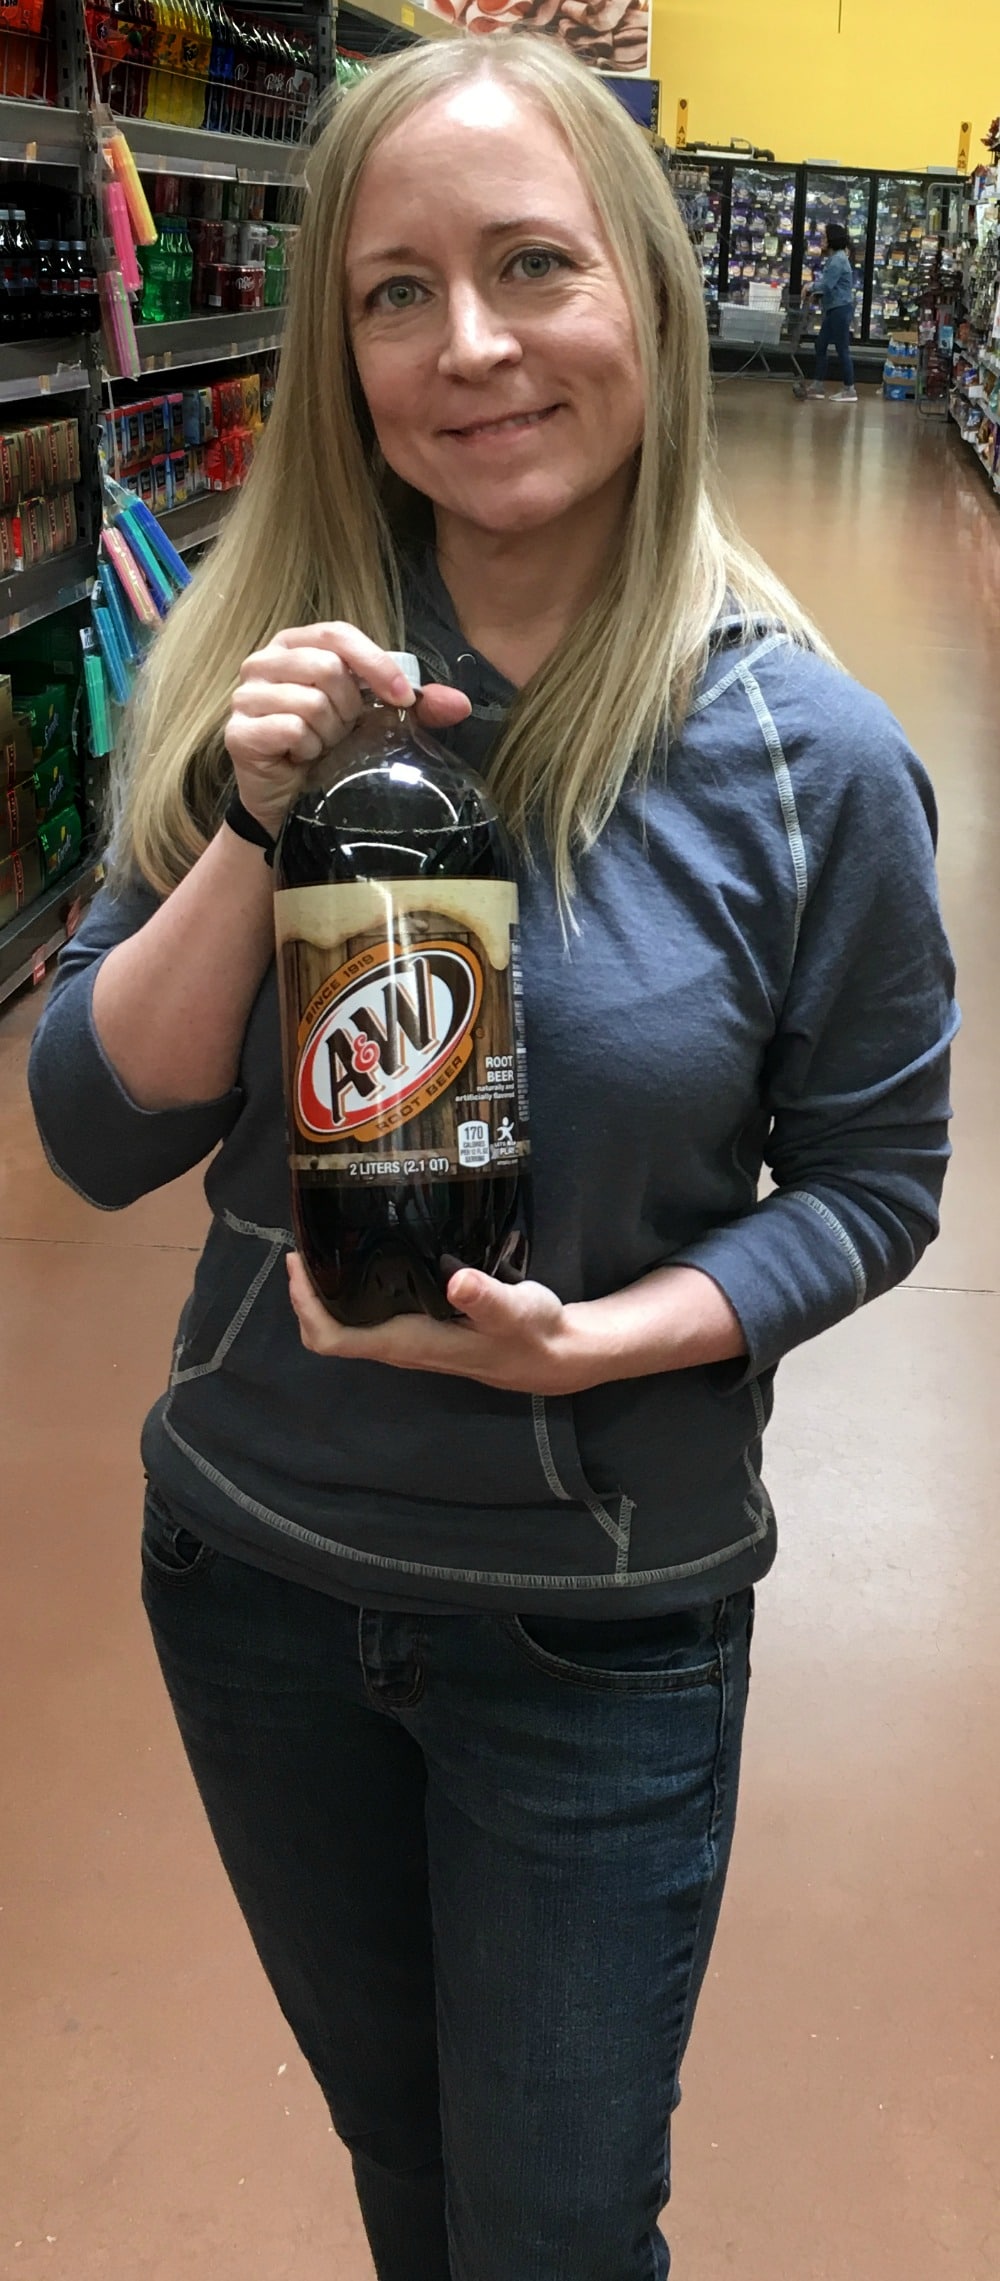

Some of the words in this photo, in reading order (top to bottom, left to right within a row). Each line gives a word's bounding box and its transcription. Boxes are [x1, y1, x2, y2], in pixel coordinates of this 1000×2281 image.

[306, 979, 341, 1024] SINCE
[343, 954, 374, 978] 1919
[325, 956, 439, 1126] A&W
[486, 1055, 513, 1068] ROOT
[487, 1070, 514, 1082] BEER
[376, 1097, 421, 1131] ROOT
[426, 1056, 463, 1096] BEER
[455, 1093, 492, 1102] artificially
[464, 1126, 483, 1140] 170
[350, 1163, 358, 1176] 2
[360, 1161, 400, 1175] LITERS
[403, 1159, 425, 1175] (2.1
[429, 1158, 449, 1173] QT)
